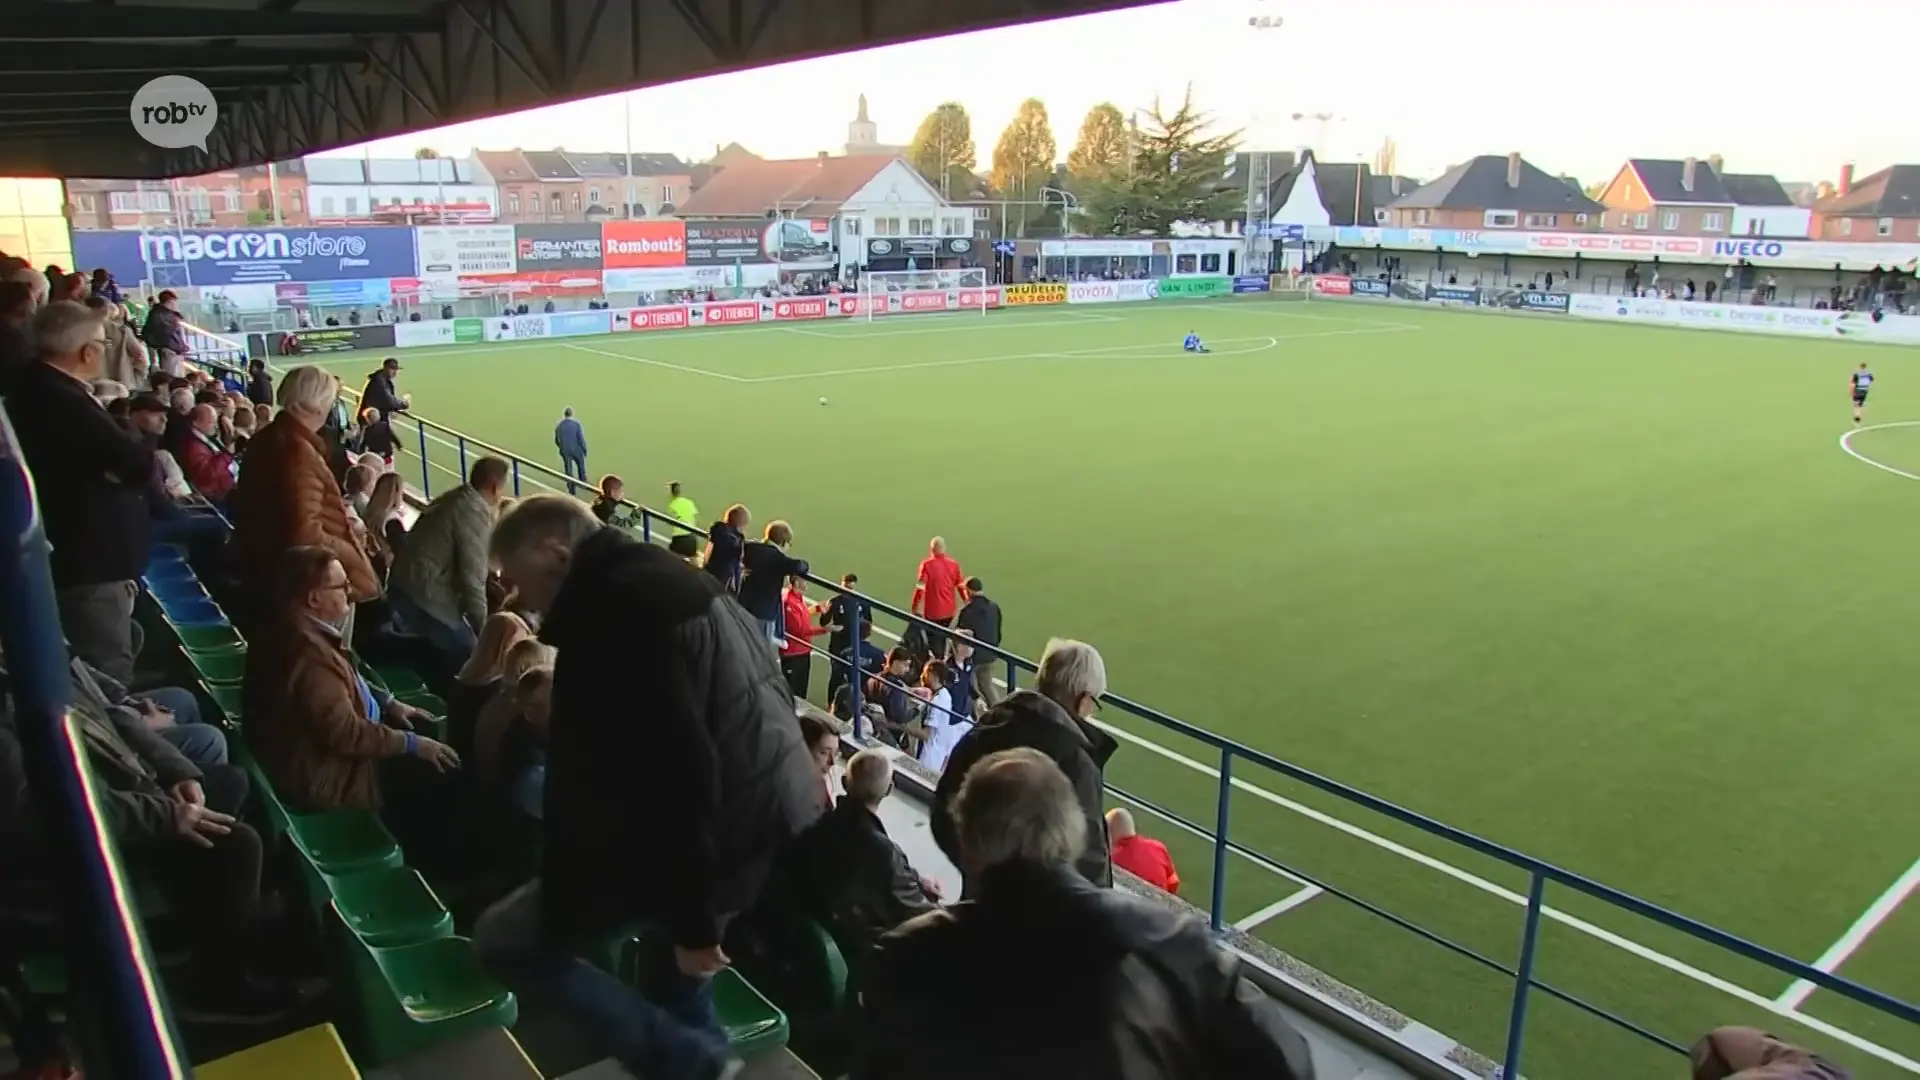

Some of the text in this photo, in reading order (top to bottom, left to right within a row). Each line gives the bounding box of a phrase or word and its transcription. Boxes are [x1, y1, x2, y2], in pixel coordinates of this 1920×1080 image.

[139, 232, 366, 260] macron store
[606, 237, 683, 254] Rombouts
[1715, 241, 1783, 257] IVECO
[1071, 286, 1114, 298] TOYOTA
